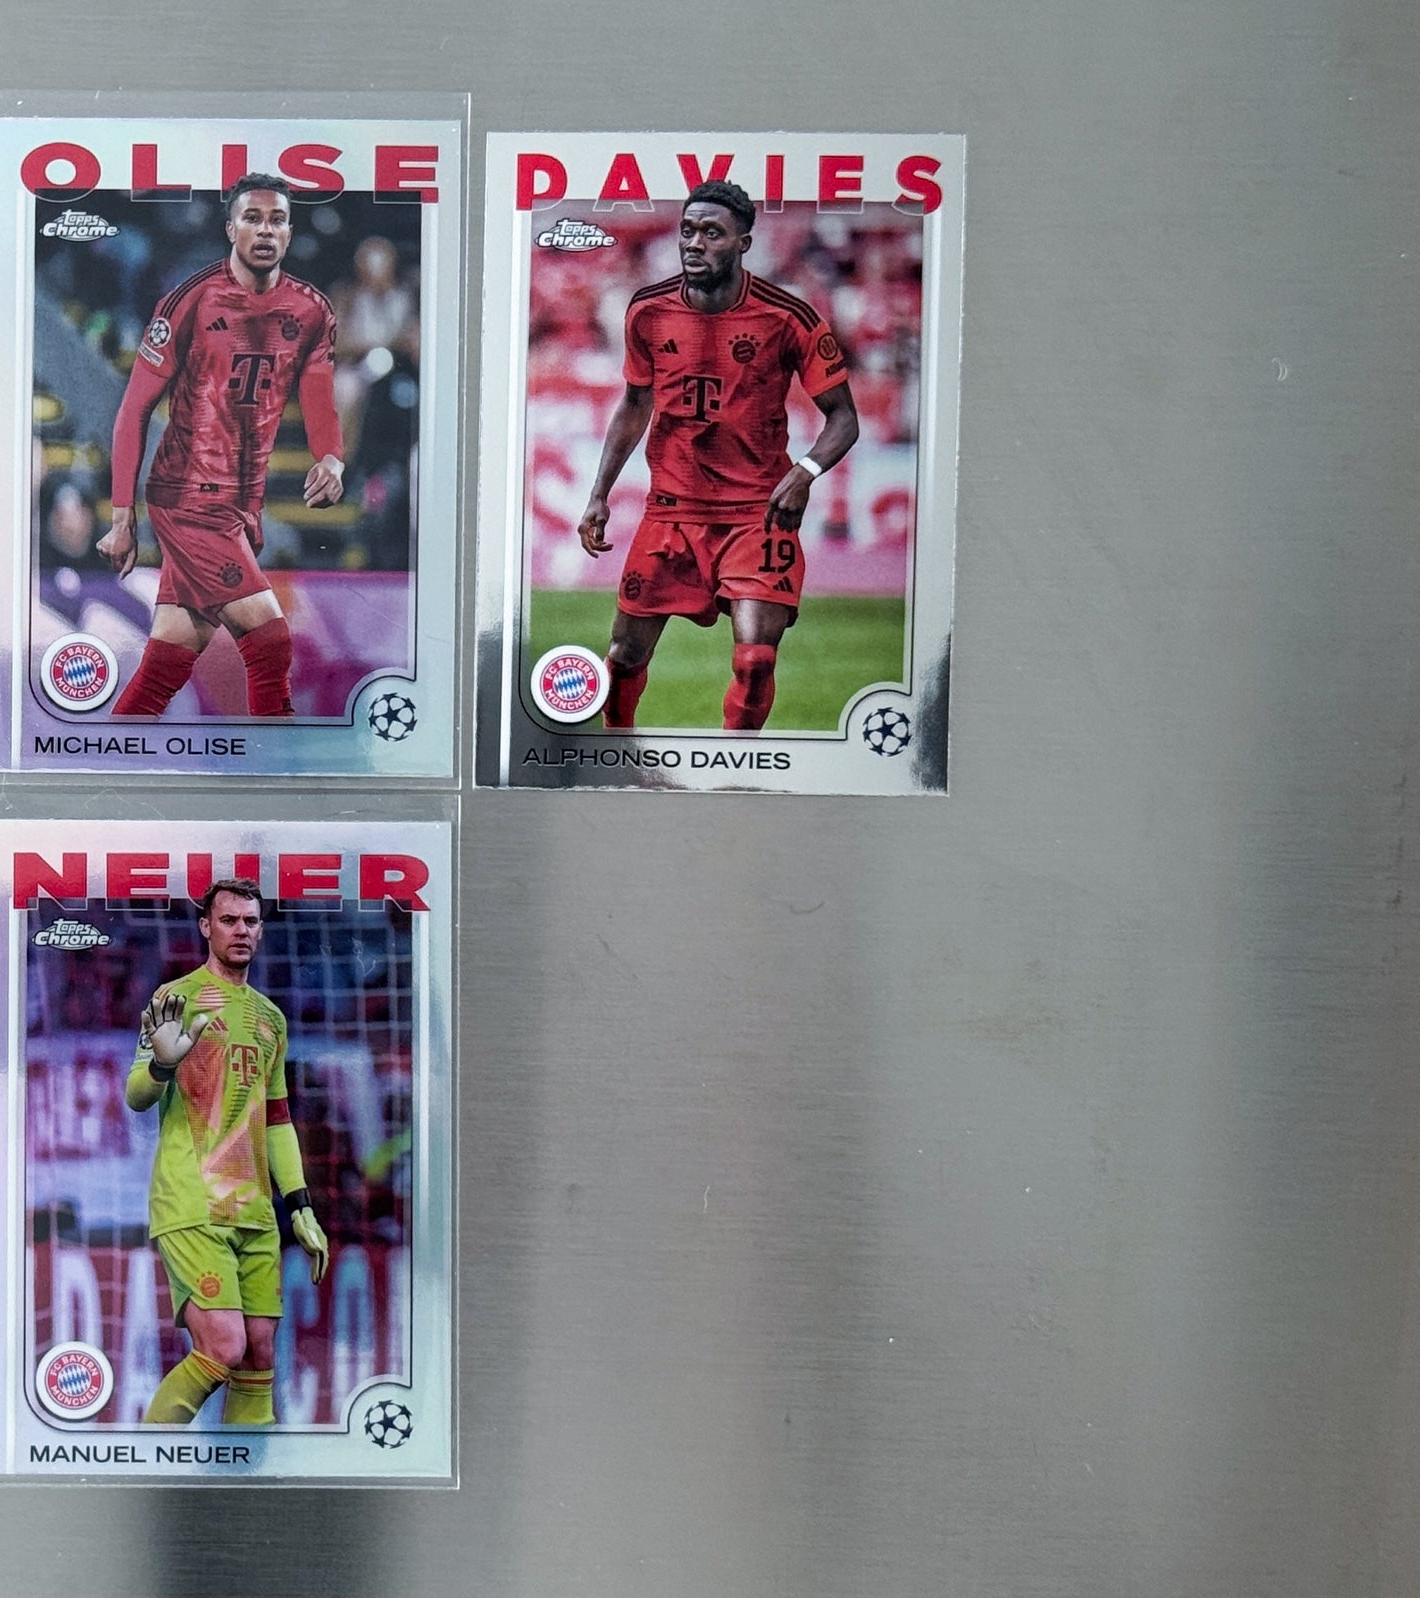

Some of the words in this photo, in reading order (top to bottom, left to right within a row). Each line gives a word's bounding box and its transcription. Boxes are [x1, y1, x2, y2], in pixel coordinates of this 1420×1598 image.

[20, 142, 439, 204] OLISE
[516, 153, 942, 216] DAVIES
[42, 222, 118, 237] Chrome
[538, 232, 616, 247] Chrome
[758, 538, 796, 573] 19
[54, 652, 68, 668] FC
[68, 644, 103, 669] BAYERN
[546, 665, 559, 680] FC
[559, 657, 594, 681] BAYERN
[34, 736, 157, 755] MICHAEL
[167, 737, 246, 756] OLISE
[522, 748, 681, 768] ALPHONSO
[691, 751, 791, 771] DAVIES
[13, 852, 431, 912] NEUER
[35, 931, 110, 946] Chrome
[50, 1361, 63, 1376] FC
[63, 1351, 98, 1377] BAYERN
[29, 1445, 146, 1464] MANUEL
[156, 1445, 250, 1464] NEUER
